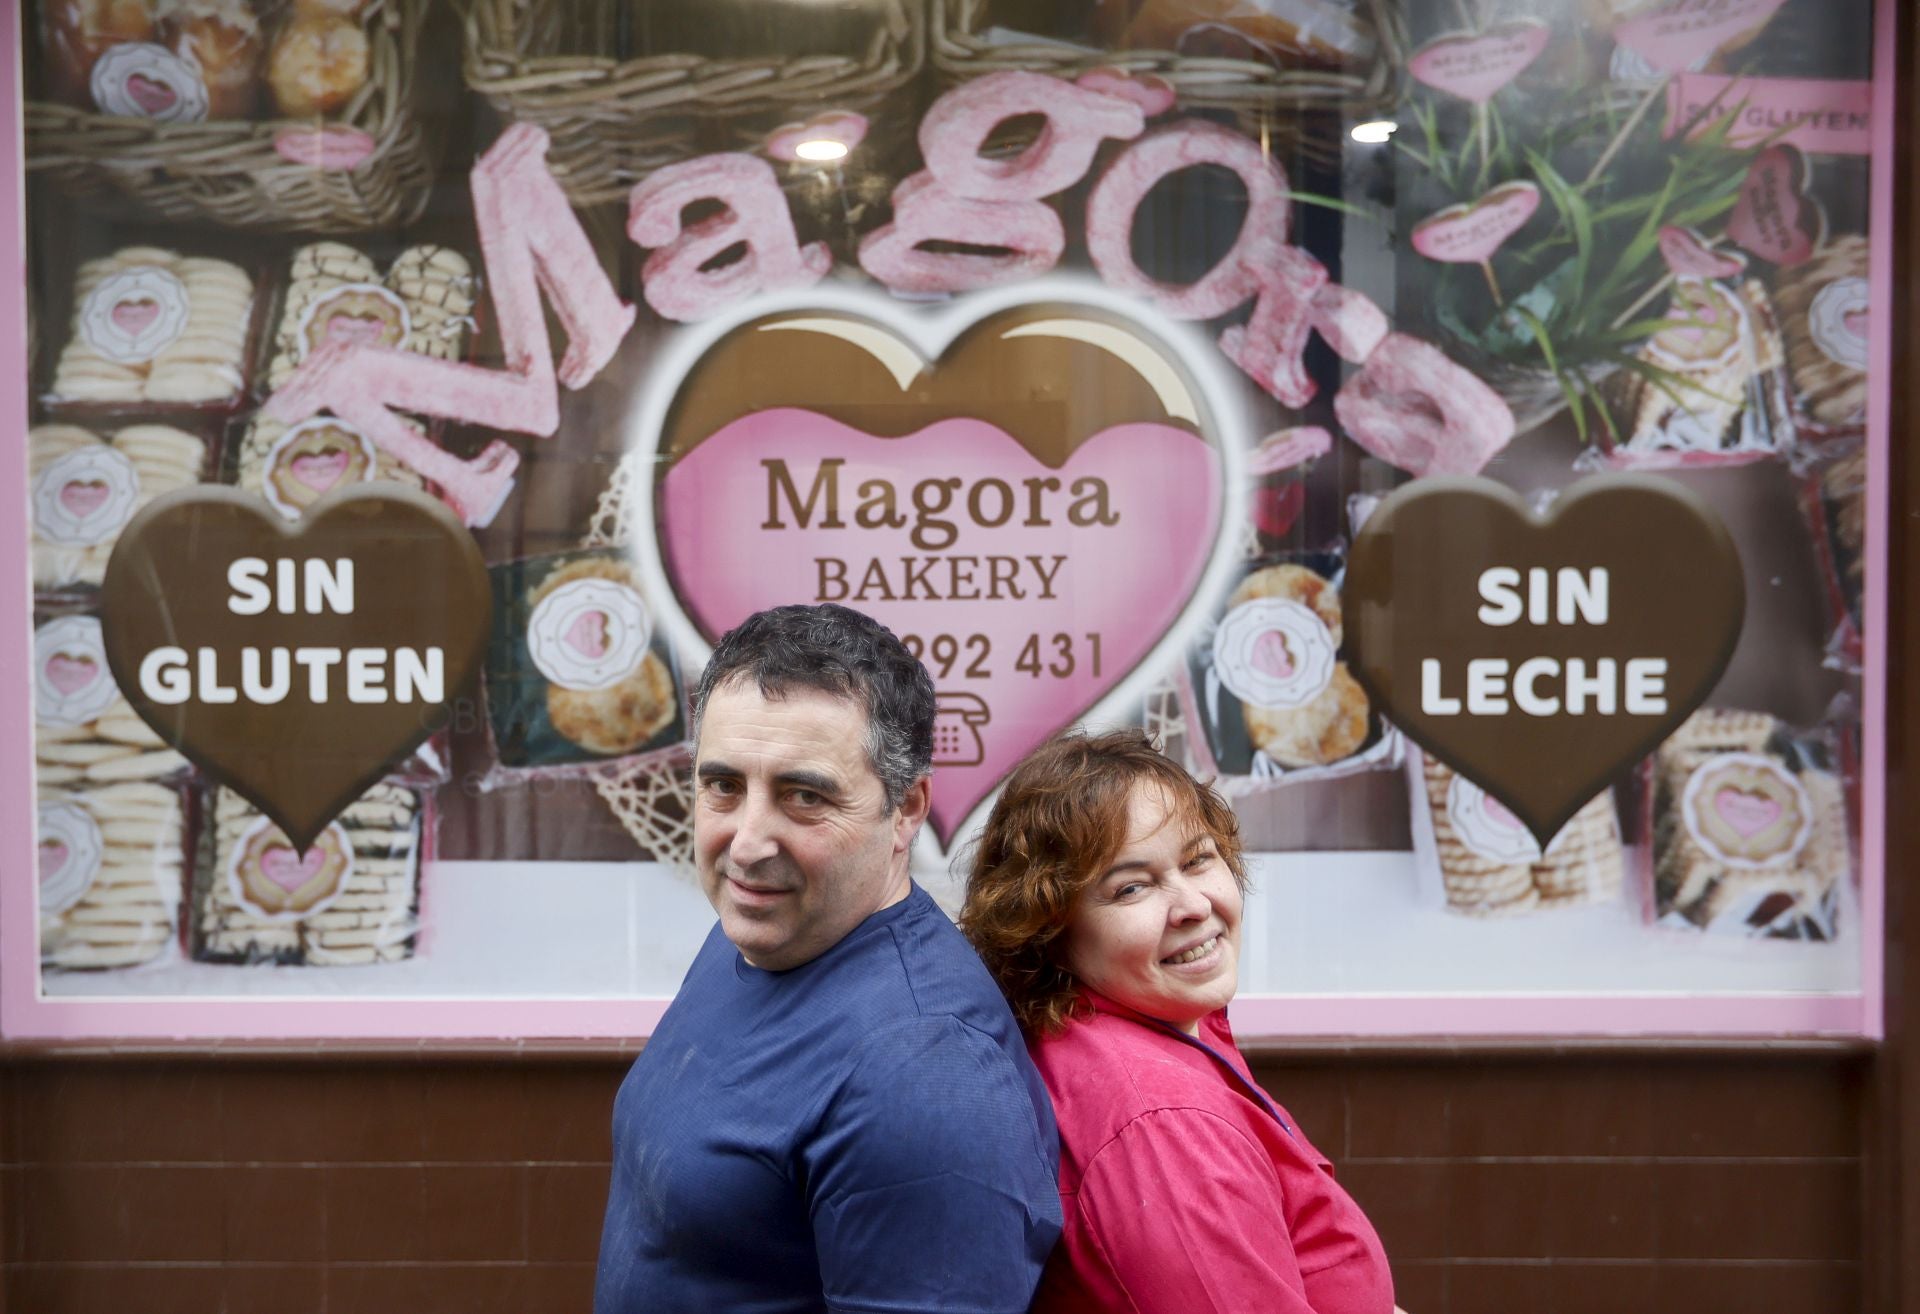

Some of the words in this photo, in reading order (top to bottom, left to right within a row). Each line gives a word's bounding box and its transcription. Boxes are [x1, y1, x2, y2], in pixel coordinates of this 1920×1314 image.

[760, 457, 1120, 551] Magora
[227, 557, 354, 615] SIN
[814, 556, 1067, 601] BAKERY
[1477, 566, 1609, 626] SIN
[139, 646, 444, 704] GLUTEN
[1015, 632, 1101, 679] 431
[1421, 656, 1668, 716] LECHE
